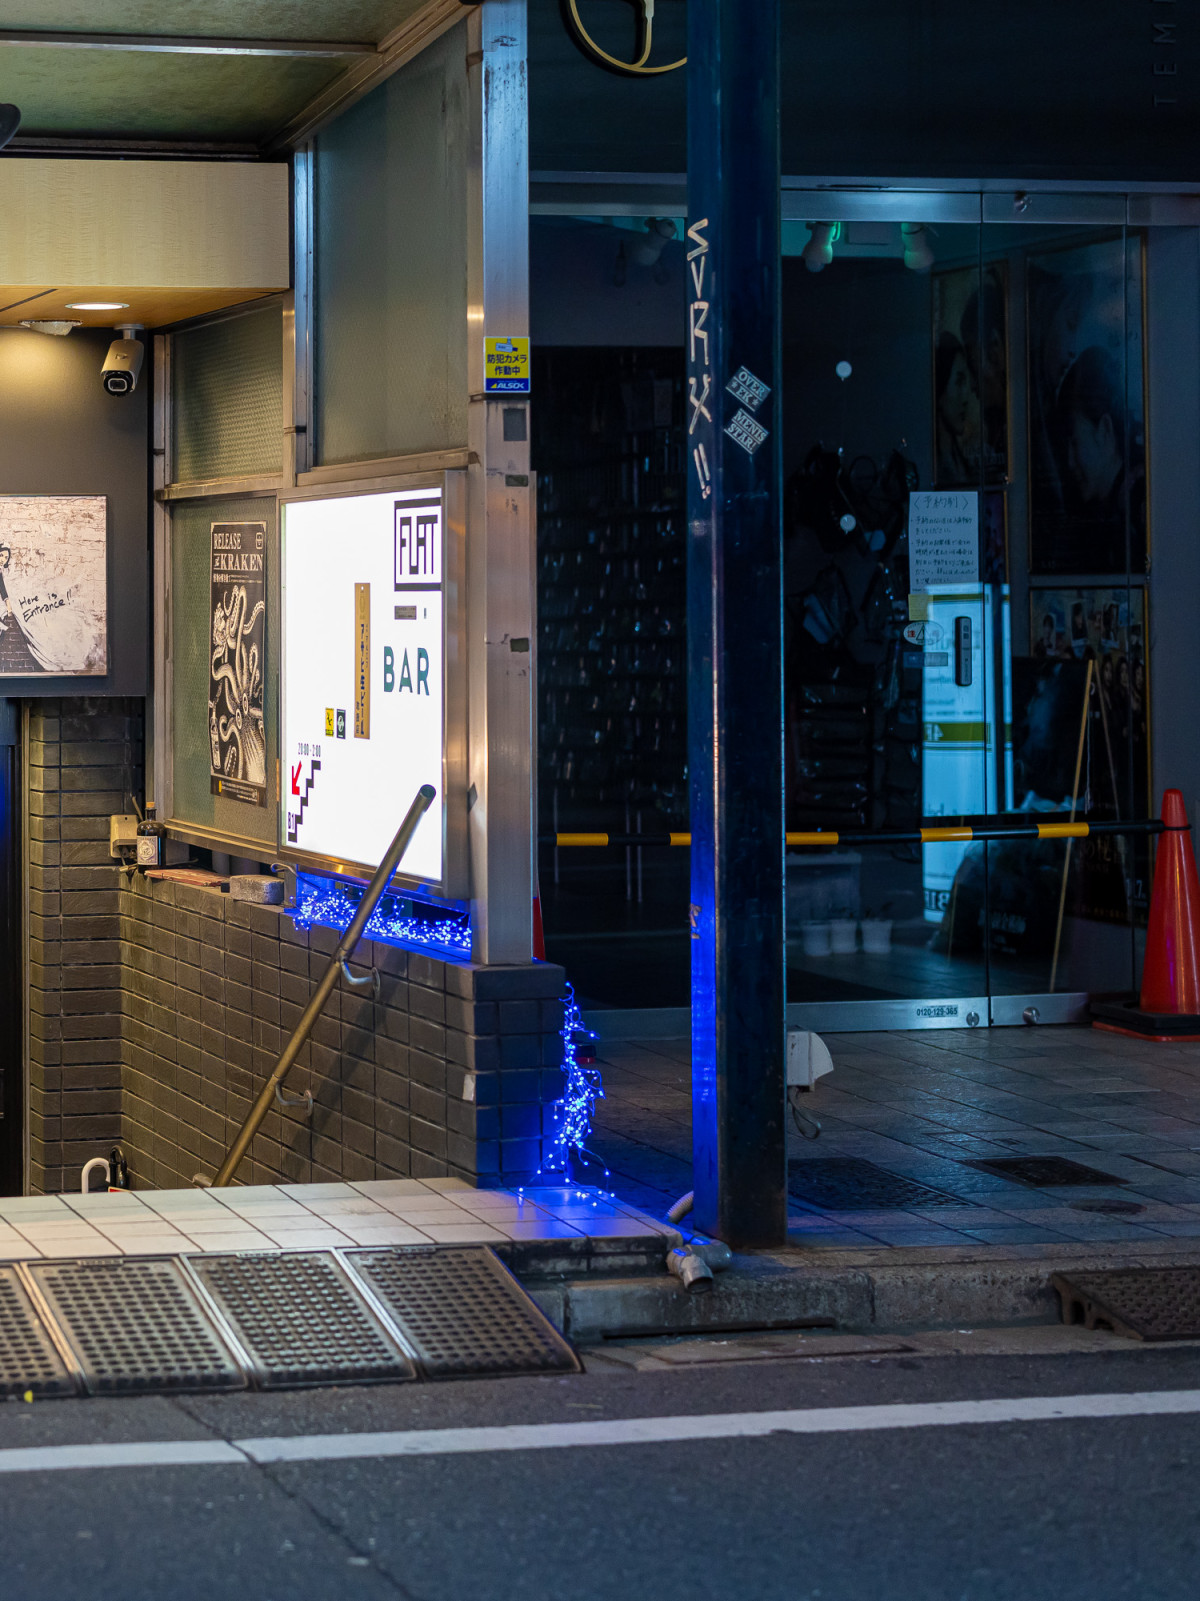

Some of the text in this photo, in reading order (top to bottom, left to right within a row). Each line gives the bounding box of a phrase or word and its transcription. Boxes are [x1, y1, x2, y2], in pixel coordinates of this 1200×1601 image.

[1153, 0, 1177, 107] TEM
[487, 354, 527, 364] 防犯カメラ
[494, 366, 521, 376] 作動中
[496, 382, 525, 390] ALSOK
[738, 371, 765, 397] OVER
[213, 533, 242, 550] RELEASE
[221, 553, 263, 571] KRAKEN
[18, 592, 58, 610] Here is
[383, 645, 430, 696] BAR
